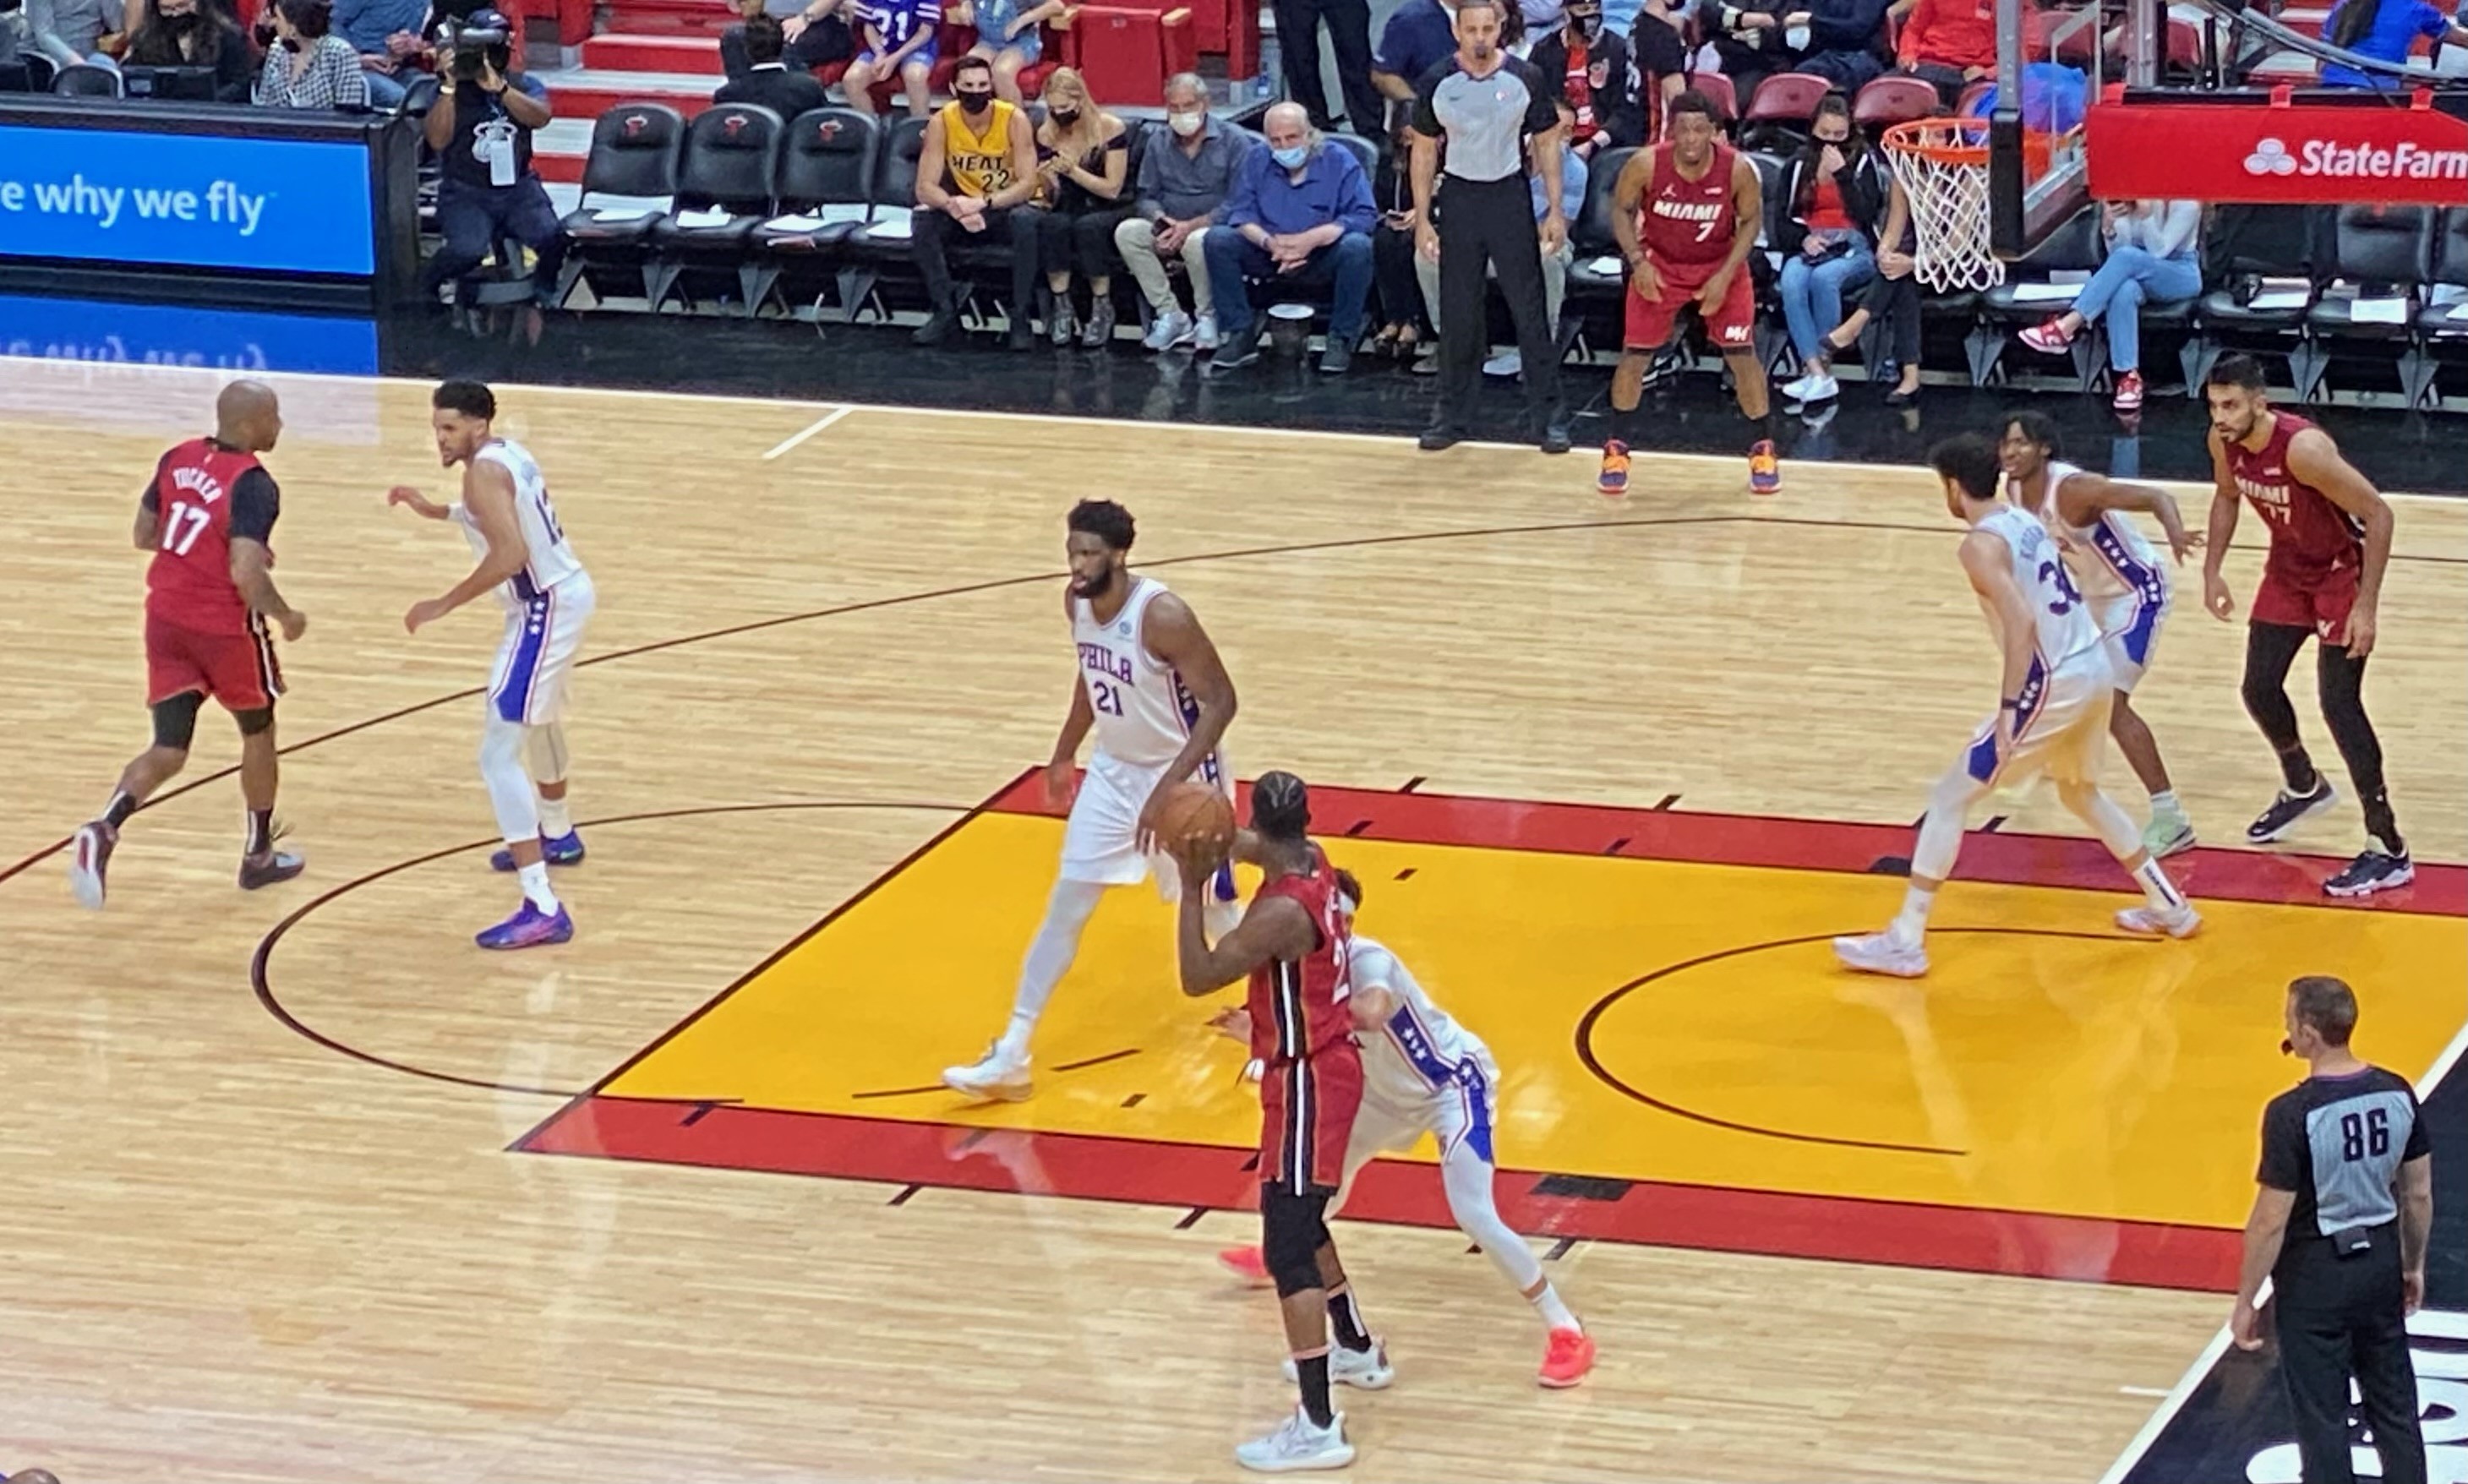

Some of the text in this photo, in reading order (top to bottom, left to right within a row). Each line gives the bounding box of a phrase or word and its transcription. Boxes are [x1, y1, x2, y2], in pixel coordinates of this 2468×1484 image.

[952, 155, 1003, 171] HEAT
[981, 169, 1009, 194] 22
[0, 173, 265, 237] e why we fly
[1652, 199, 1723, 221] MIAMI
[1695, 221, 1716, 243] 7
[172, 466, 222, 505] TUCKER
[2234, 474, 2290, 504] MIAMI
[162, 501, 210, 556] 17
[1077, 641, 1135, 688] PHILA
[1093, 681, 1124, 717] 21
[2340, 1107, 2389, 1163] 86
